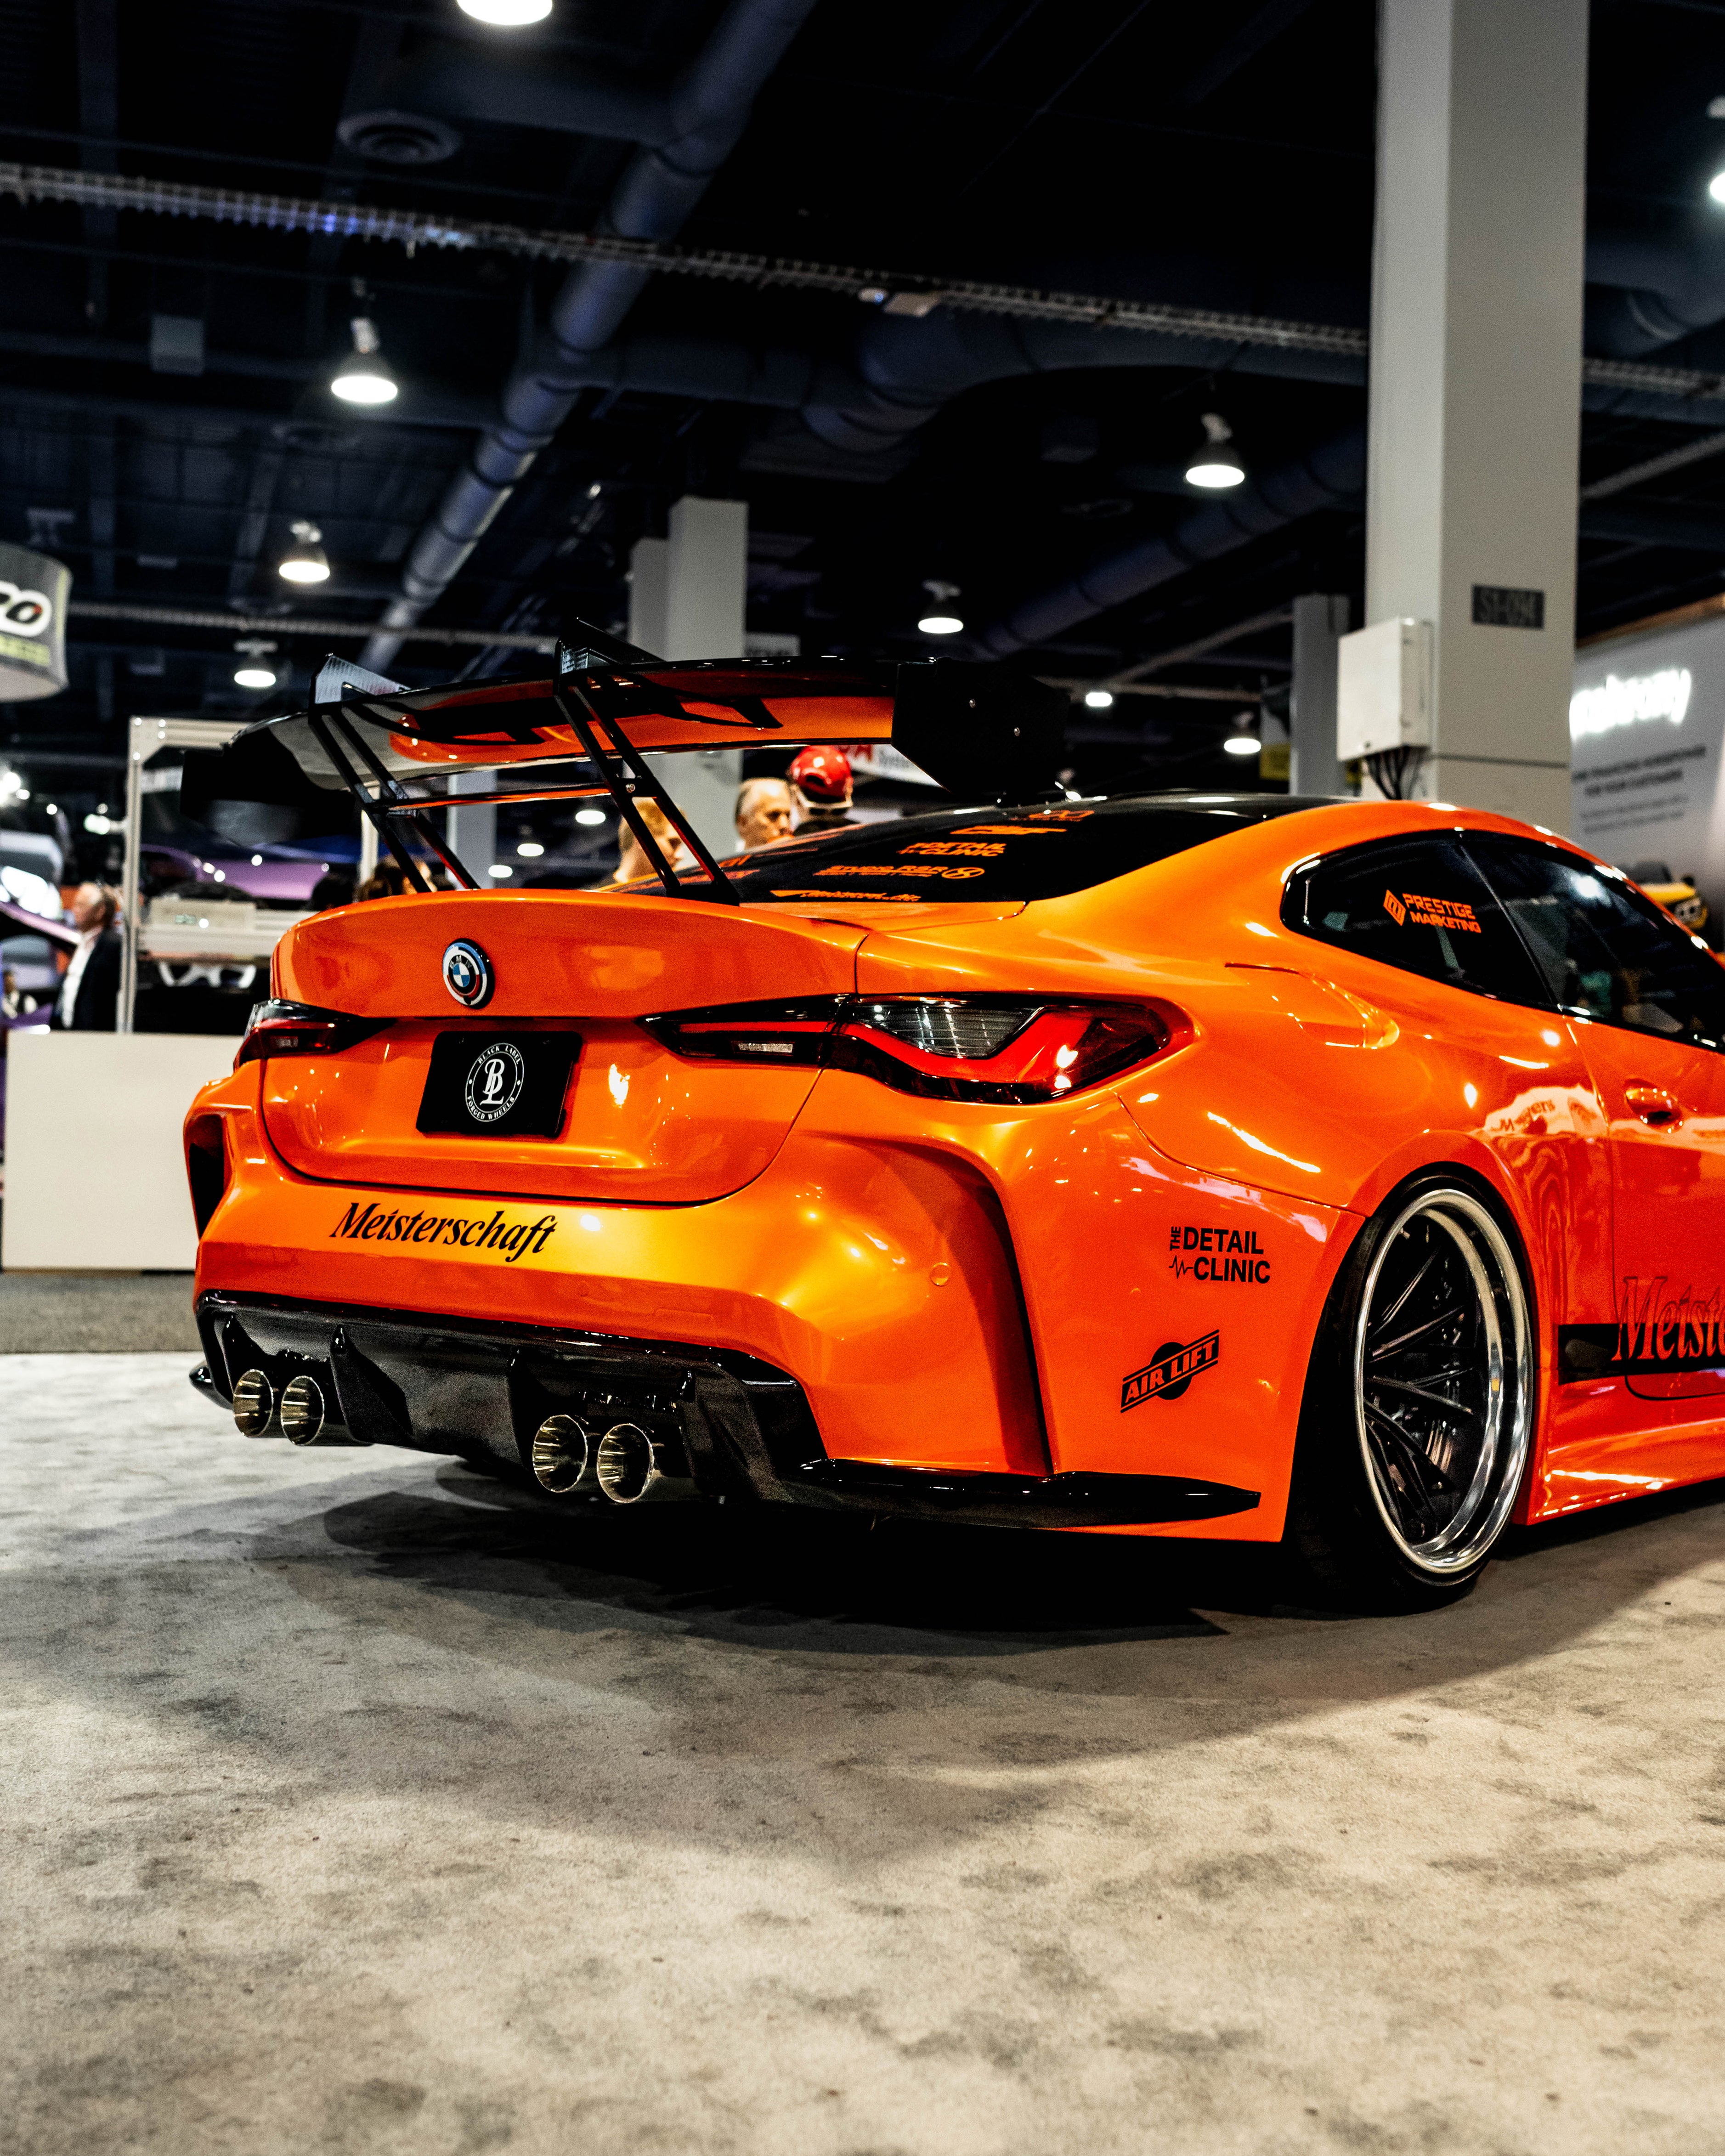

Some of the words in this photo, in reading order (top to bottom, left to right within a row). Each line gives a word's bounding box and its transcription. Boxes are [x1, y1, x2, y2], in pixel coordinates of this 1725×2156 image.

[1402, 893, 1476, 920] PRESTIGE
[1409, 911, 1482, 934] MARKETING
[449, 955, 472, 969] BMW
[478, 1045, 500, 1064] BLACK
[505, 1045, 521, 1065] LABEL
[467, 1095, 485, 1120] FORGED
[487, 1096, 515, 1120] WHEELS
[329, 1202, 558, 1262] Meisterschaft
[1170, 1226, 1181, 1251] THE
[1183, 1226, 1264, 1255] DETAIL
[1193, 1256, 1271, 1284] CLINIC
[1125, 1368, 1165, 1403] AIR
[1171, 1339, 1216, 1379] LIFT
